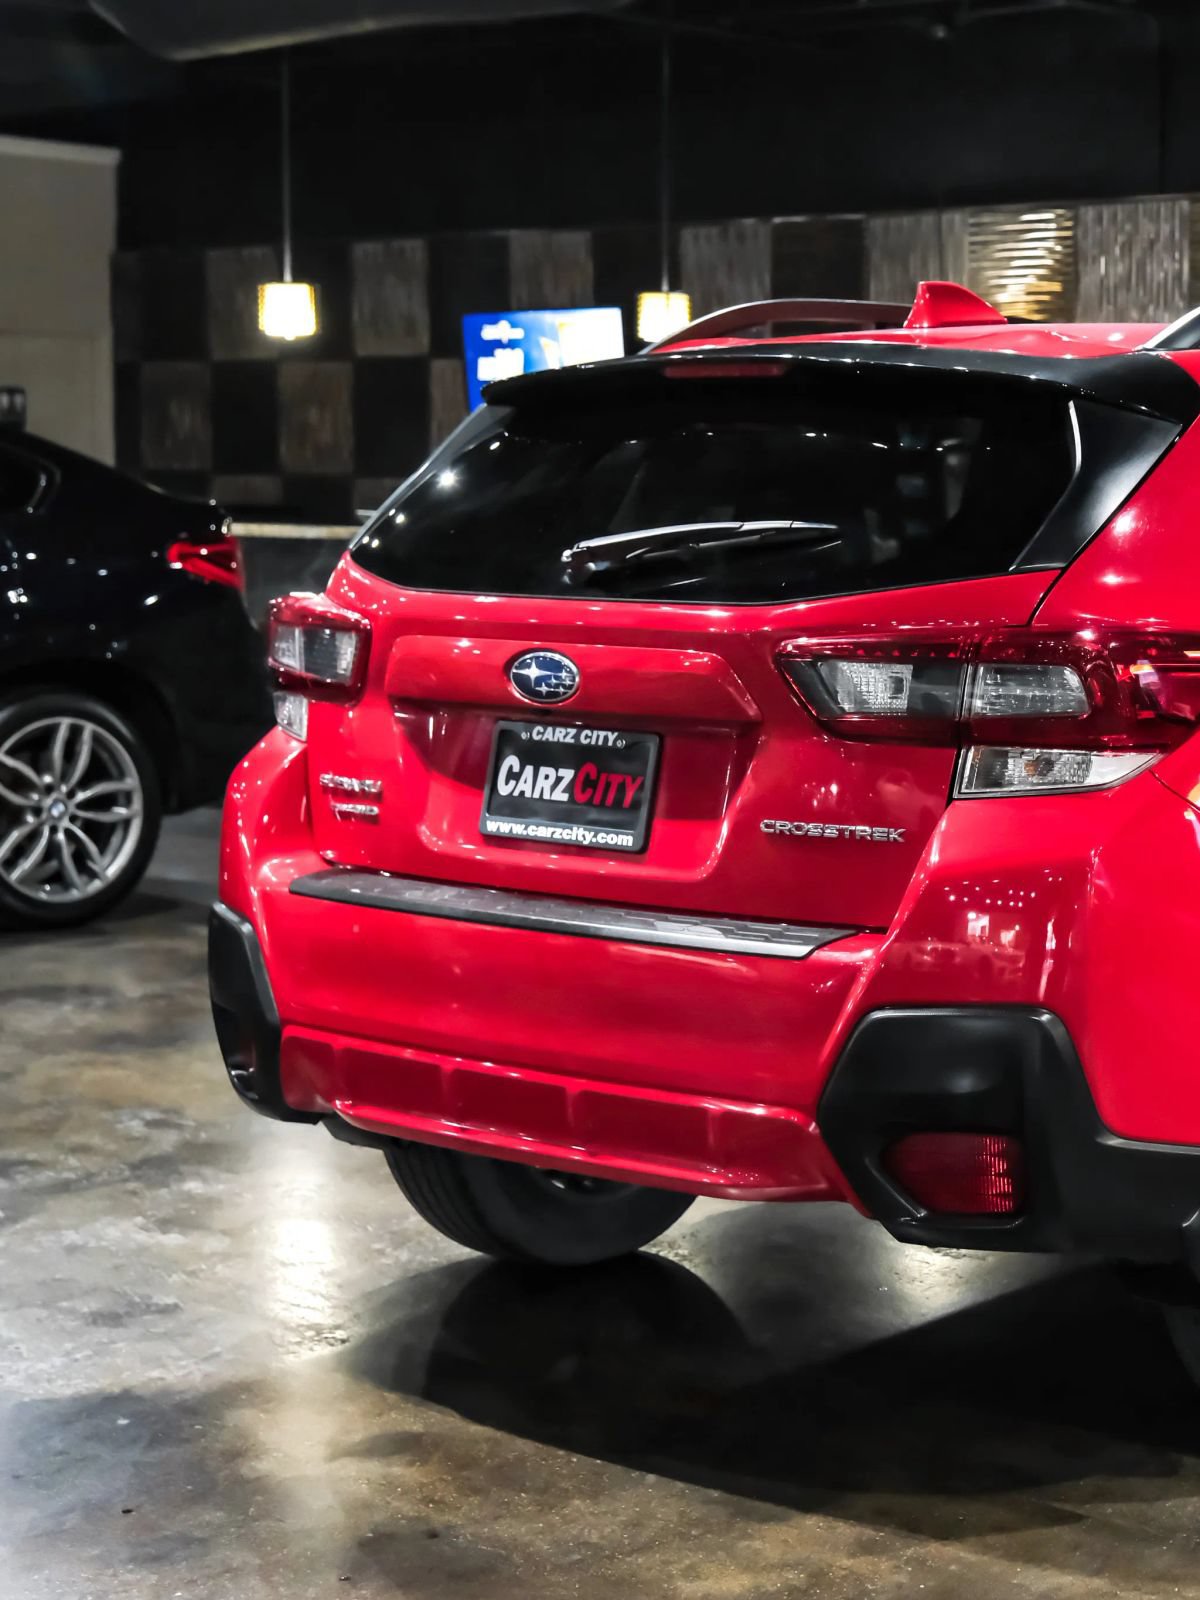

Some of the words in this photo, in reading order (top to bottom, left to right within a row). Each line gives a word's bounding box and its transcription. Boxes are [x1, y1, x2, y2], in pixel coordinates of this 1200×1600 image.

[532, 726, 577, 743] CARZ
[580, 730, 618, 747] CITY
[486, 820, 634, 847] www.carzcity.com
[759, 819, 907, 843] CROSSTREK
